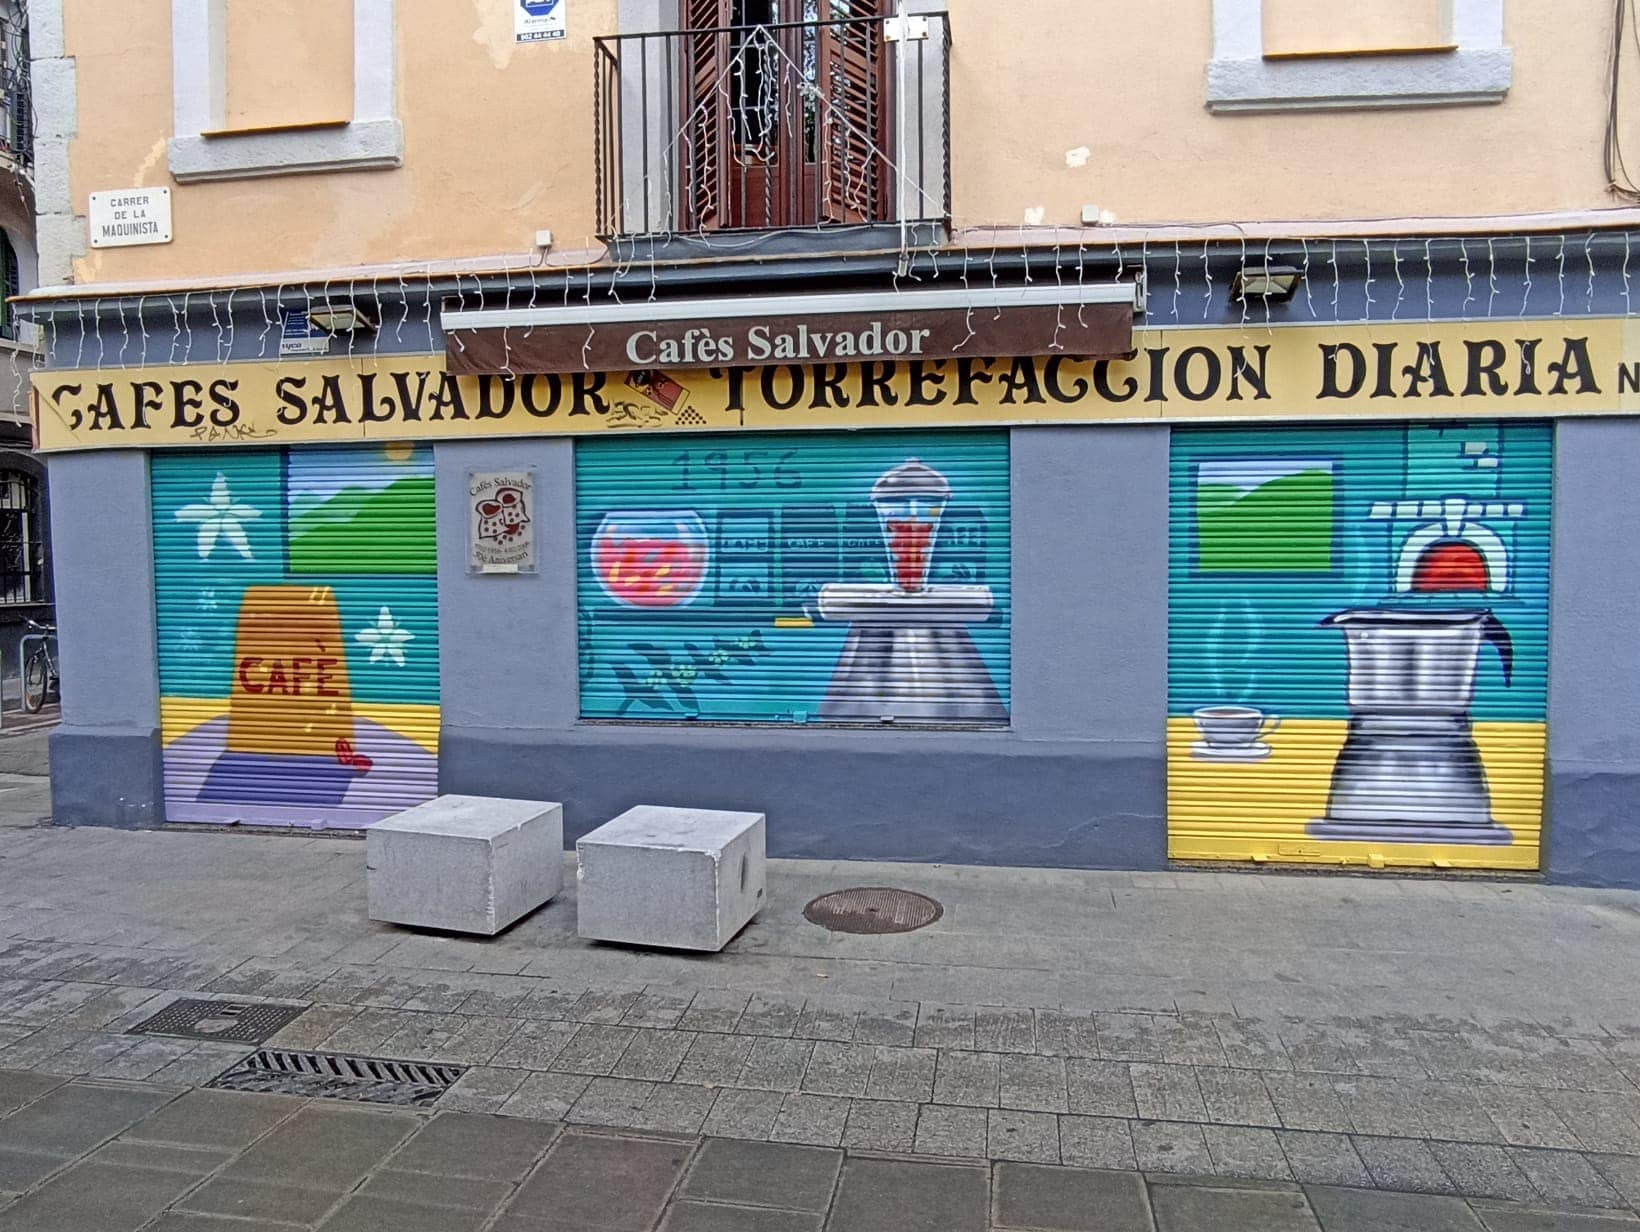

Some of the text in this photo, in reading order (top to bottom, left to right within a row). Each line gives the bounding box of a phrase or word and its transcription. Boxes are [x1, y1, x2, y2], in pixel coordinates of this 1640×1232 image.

[110, 196, 149, 207] CARRER
[114, 210, 146, 220] DE LA
[102, 221, 158, 237] MAQUINISTA
[626, 322, 930, 364] Cafès Salvador
[51, 379, 241, 431] CAFES
[276, 370, 611, 425] SALVADOR
[708, 344, 1272, 412] TORREFACCION
[1316, 337, 1602, 400] DIARIA
[672, 449, 803, 490] 1956
[494, 477, 532, 490] Salvador
